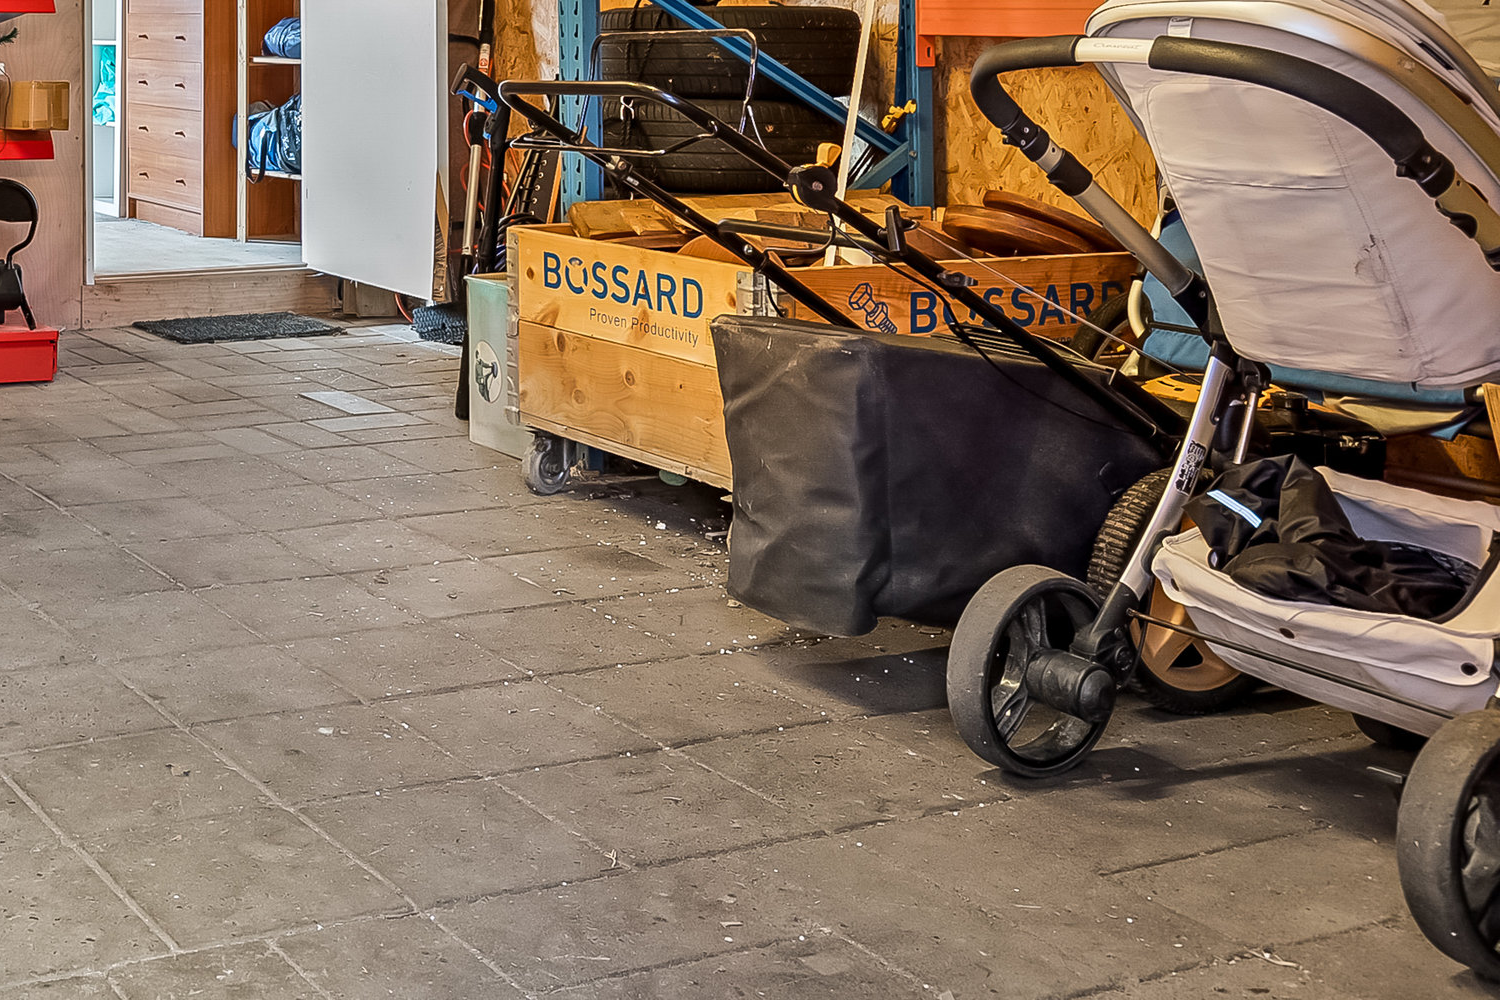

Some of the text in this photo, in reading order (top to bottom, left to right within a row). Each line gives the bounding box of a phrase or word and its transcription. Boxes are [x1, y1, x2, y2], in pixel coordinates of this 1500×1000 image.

[543, 251, 703, 319] BOSSARD
[589, 307, 699, 349] Proven Productivity
